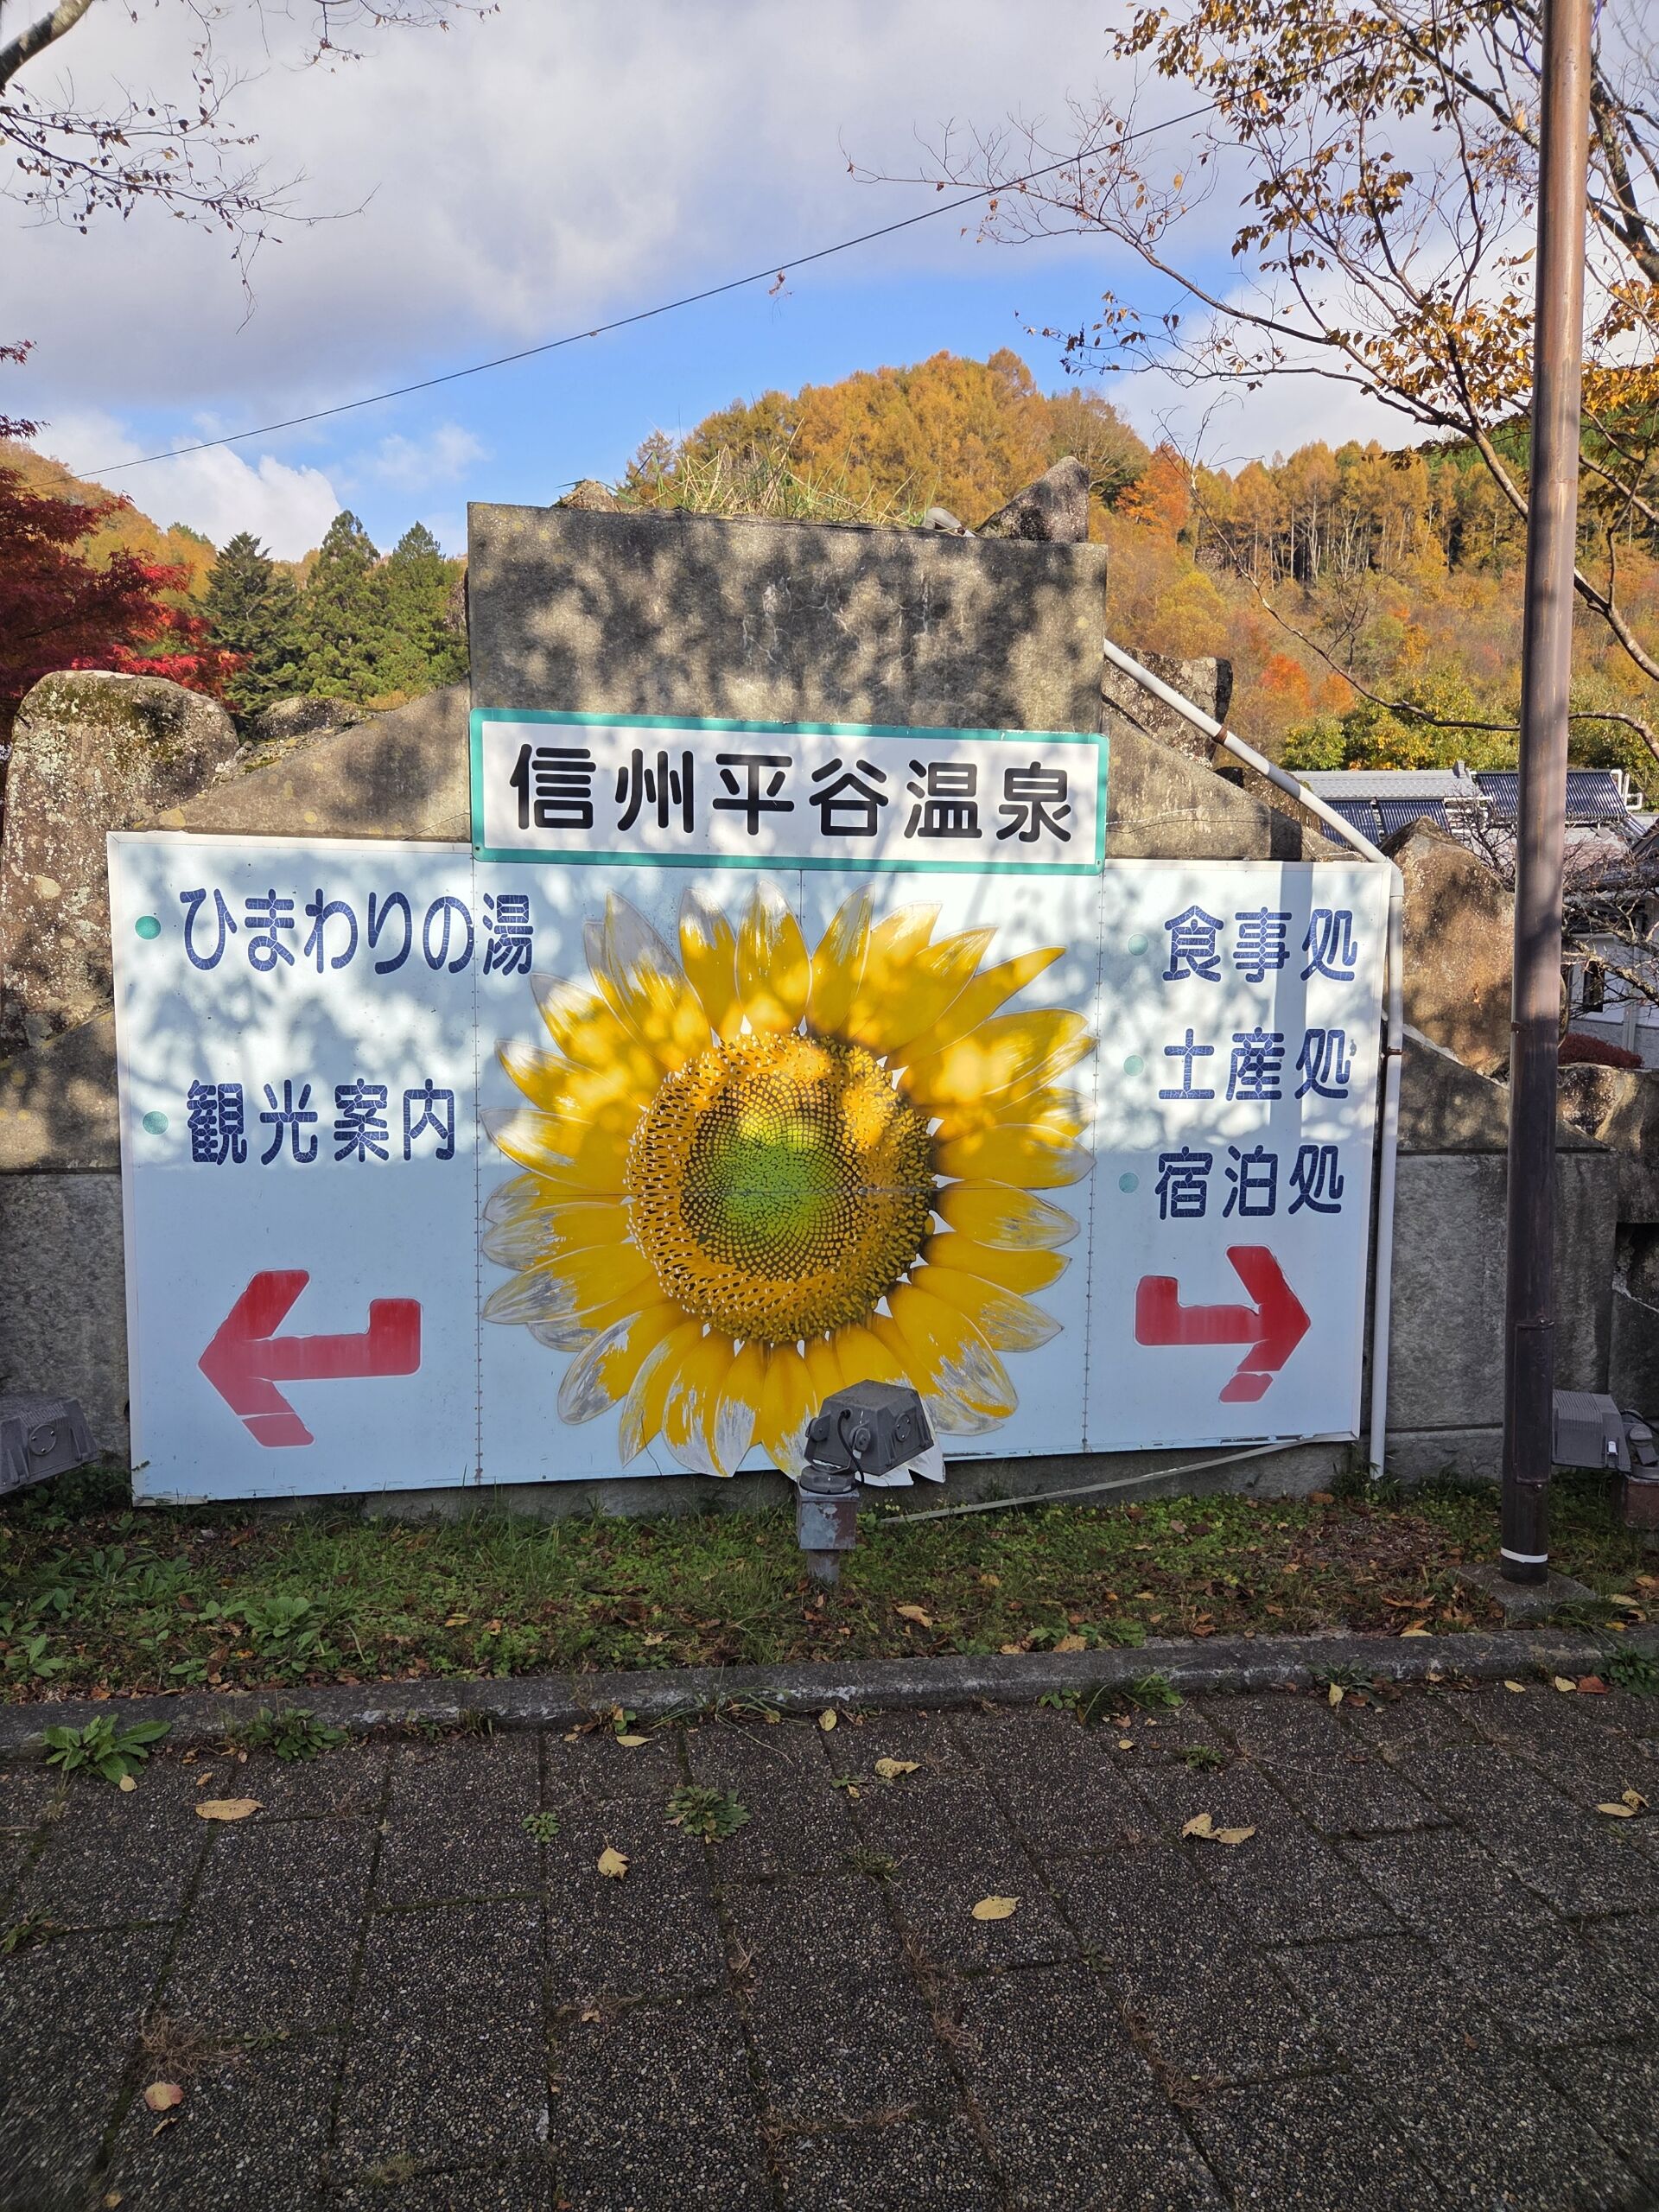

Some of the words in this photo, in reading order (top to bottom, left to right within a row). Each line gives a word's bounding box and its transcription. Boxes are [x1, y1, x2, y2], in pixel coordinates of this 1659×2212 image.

[509, 743, 1072, 843] 信州平谷温泉
[179, 887, 533, 976] ひまわりの湯
[1162, 905, 1357, 983] 食事処
[1158, 1027, 1352, 1101] 土産処
[187, 1077, 454, 1164] 観光案内
[1154, 1144, 1344, 1220] 宿泊処
